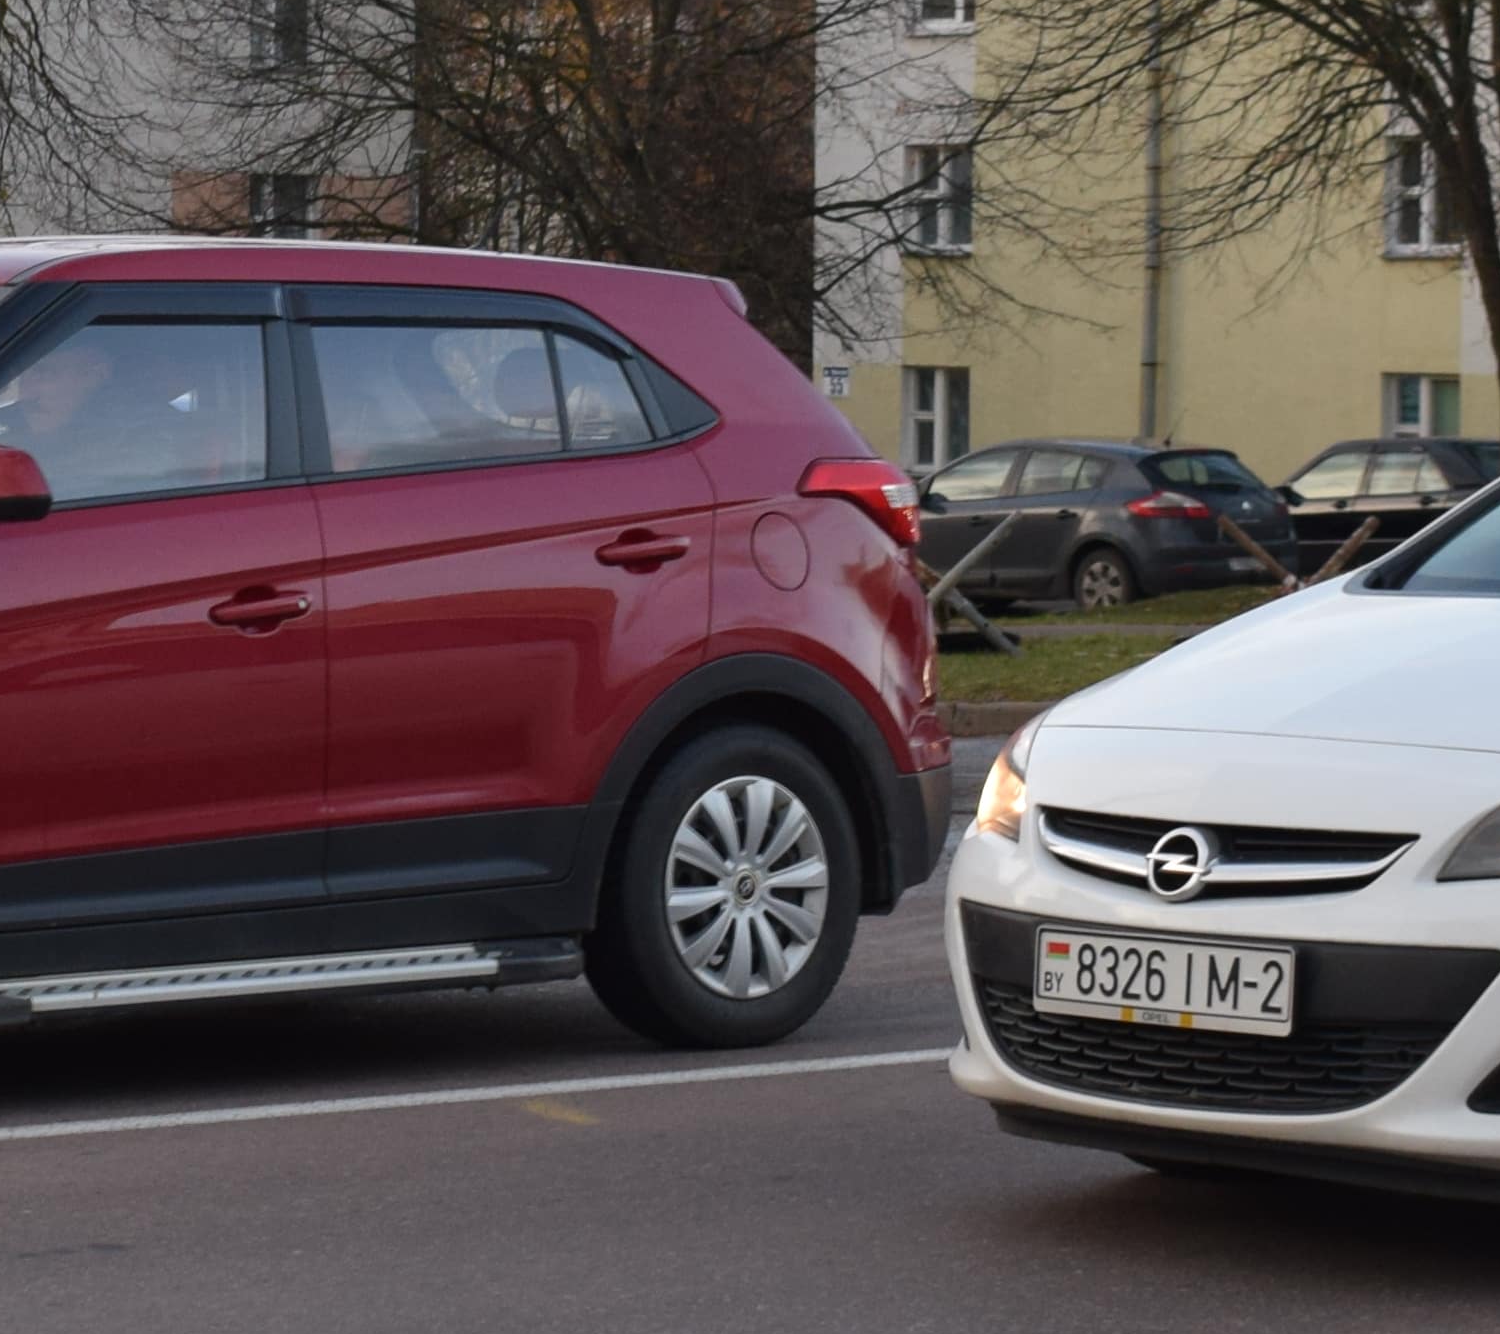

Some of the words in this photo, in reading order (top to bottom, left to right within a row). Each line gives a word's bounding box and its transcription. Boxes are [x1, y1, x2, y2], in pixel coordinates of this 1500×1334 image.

[1043, 971, 1064, 993] BY
[1076, 943, 1166, 1002] 8326
[1141, 1011, 1169, 1024] OPEL
